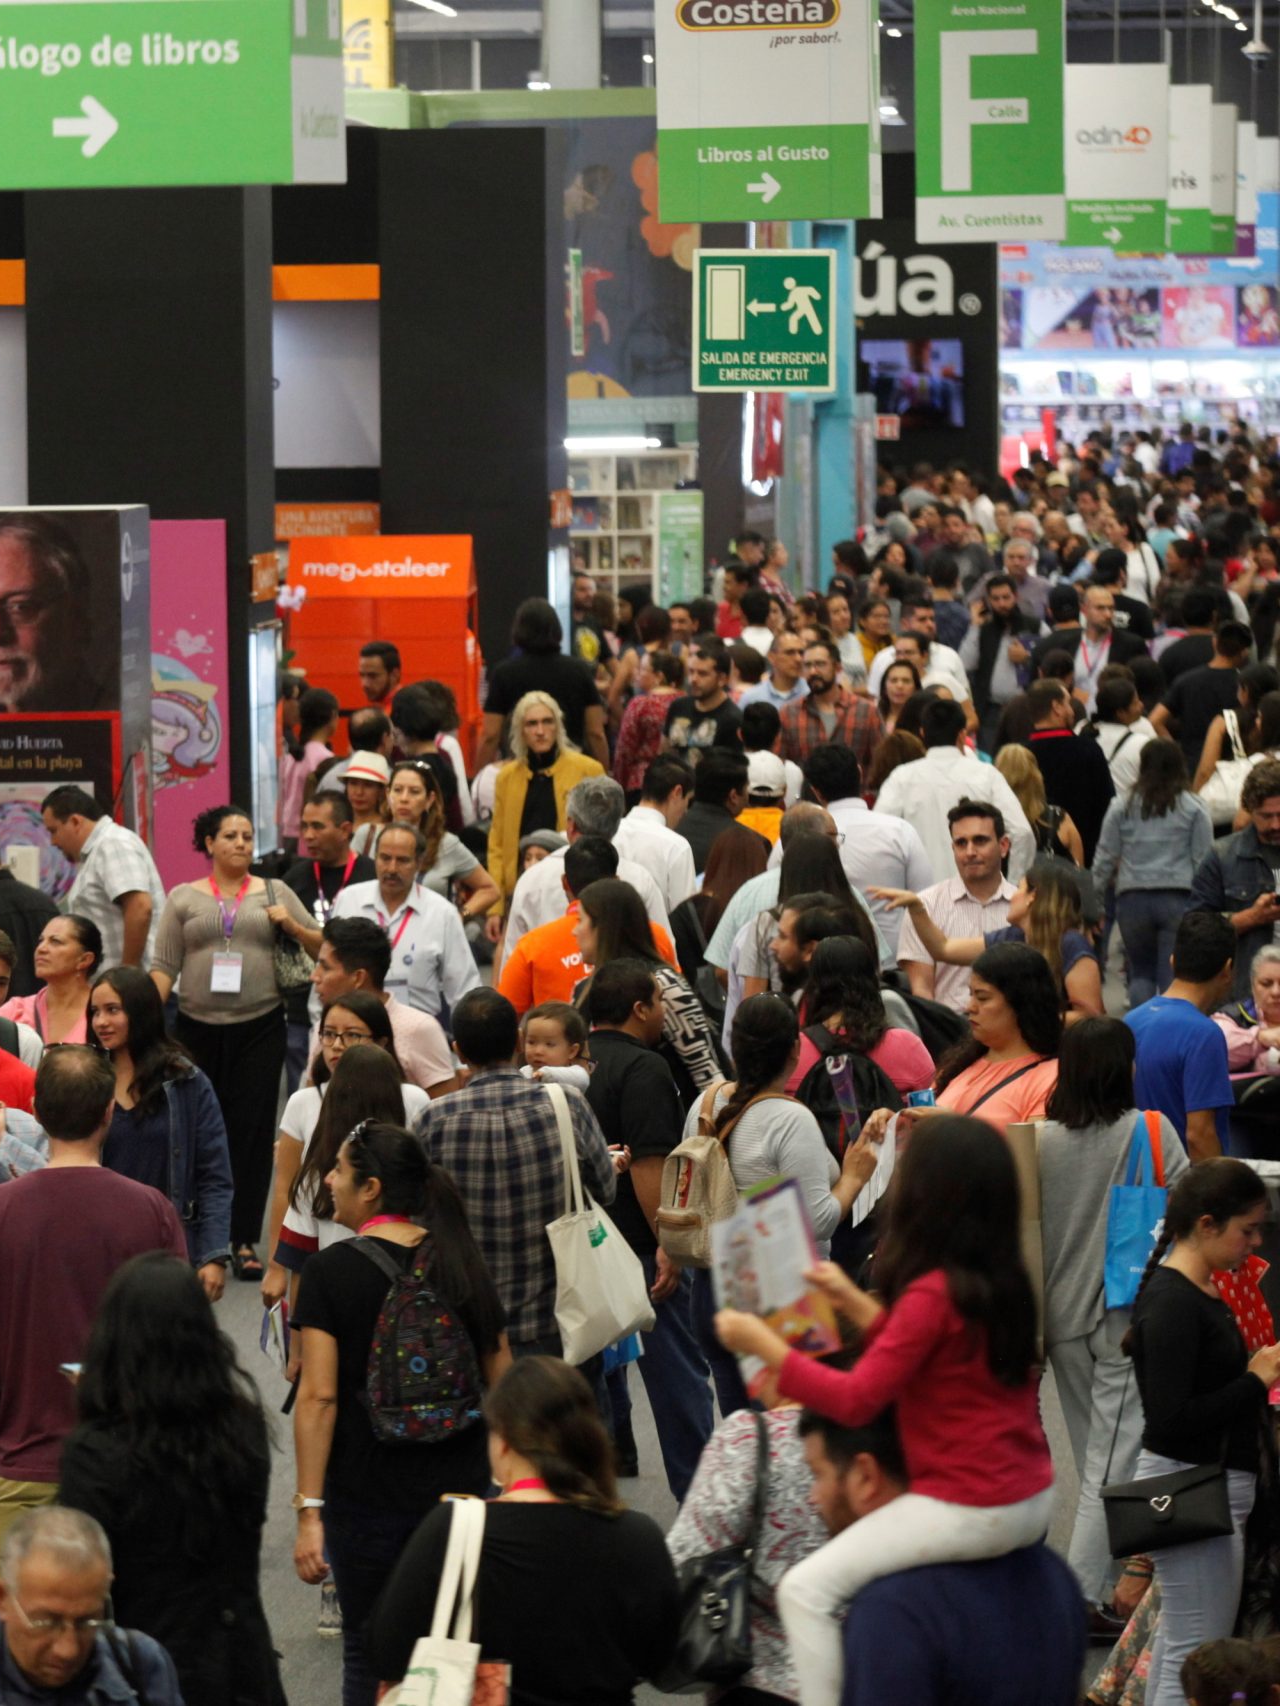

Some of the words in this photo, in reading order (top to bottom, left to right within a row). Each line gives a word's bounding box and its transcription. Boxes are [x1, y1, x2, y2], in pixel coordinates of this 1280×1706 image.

[90, 34, 132, 67] de
[141, 32, 241, 66] libros
[939, 29, 1038, 191] F
[987, 105, 1023, 119] Calle
[1076, 125, 1152, 146] adn40
[696, 147, 753, 163] Libros
[756, 146, 774, 161] al
[777, 145, 830, 161] Gusto
[937, 215, 961, 228] Av.
[963, 212, 1044, 227] Cuentistas
[701, 351, 740, 365] SALIDA
[742, 351, 758, 365] DE
[759, 351, 828, 365] EMERGENCIA
[718, 367, 782, 382] EMERGENCY
[785, 367, 809, 382] EXIT
[302, 555, 452, 582] megustaleer
[17, 758, 33, 770] en
[35, 755, 47, 770] la
[49, 755, 83, 772] playa
